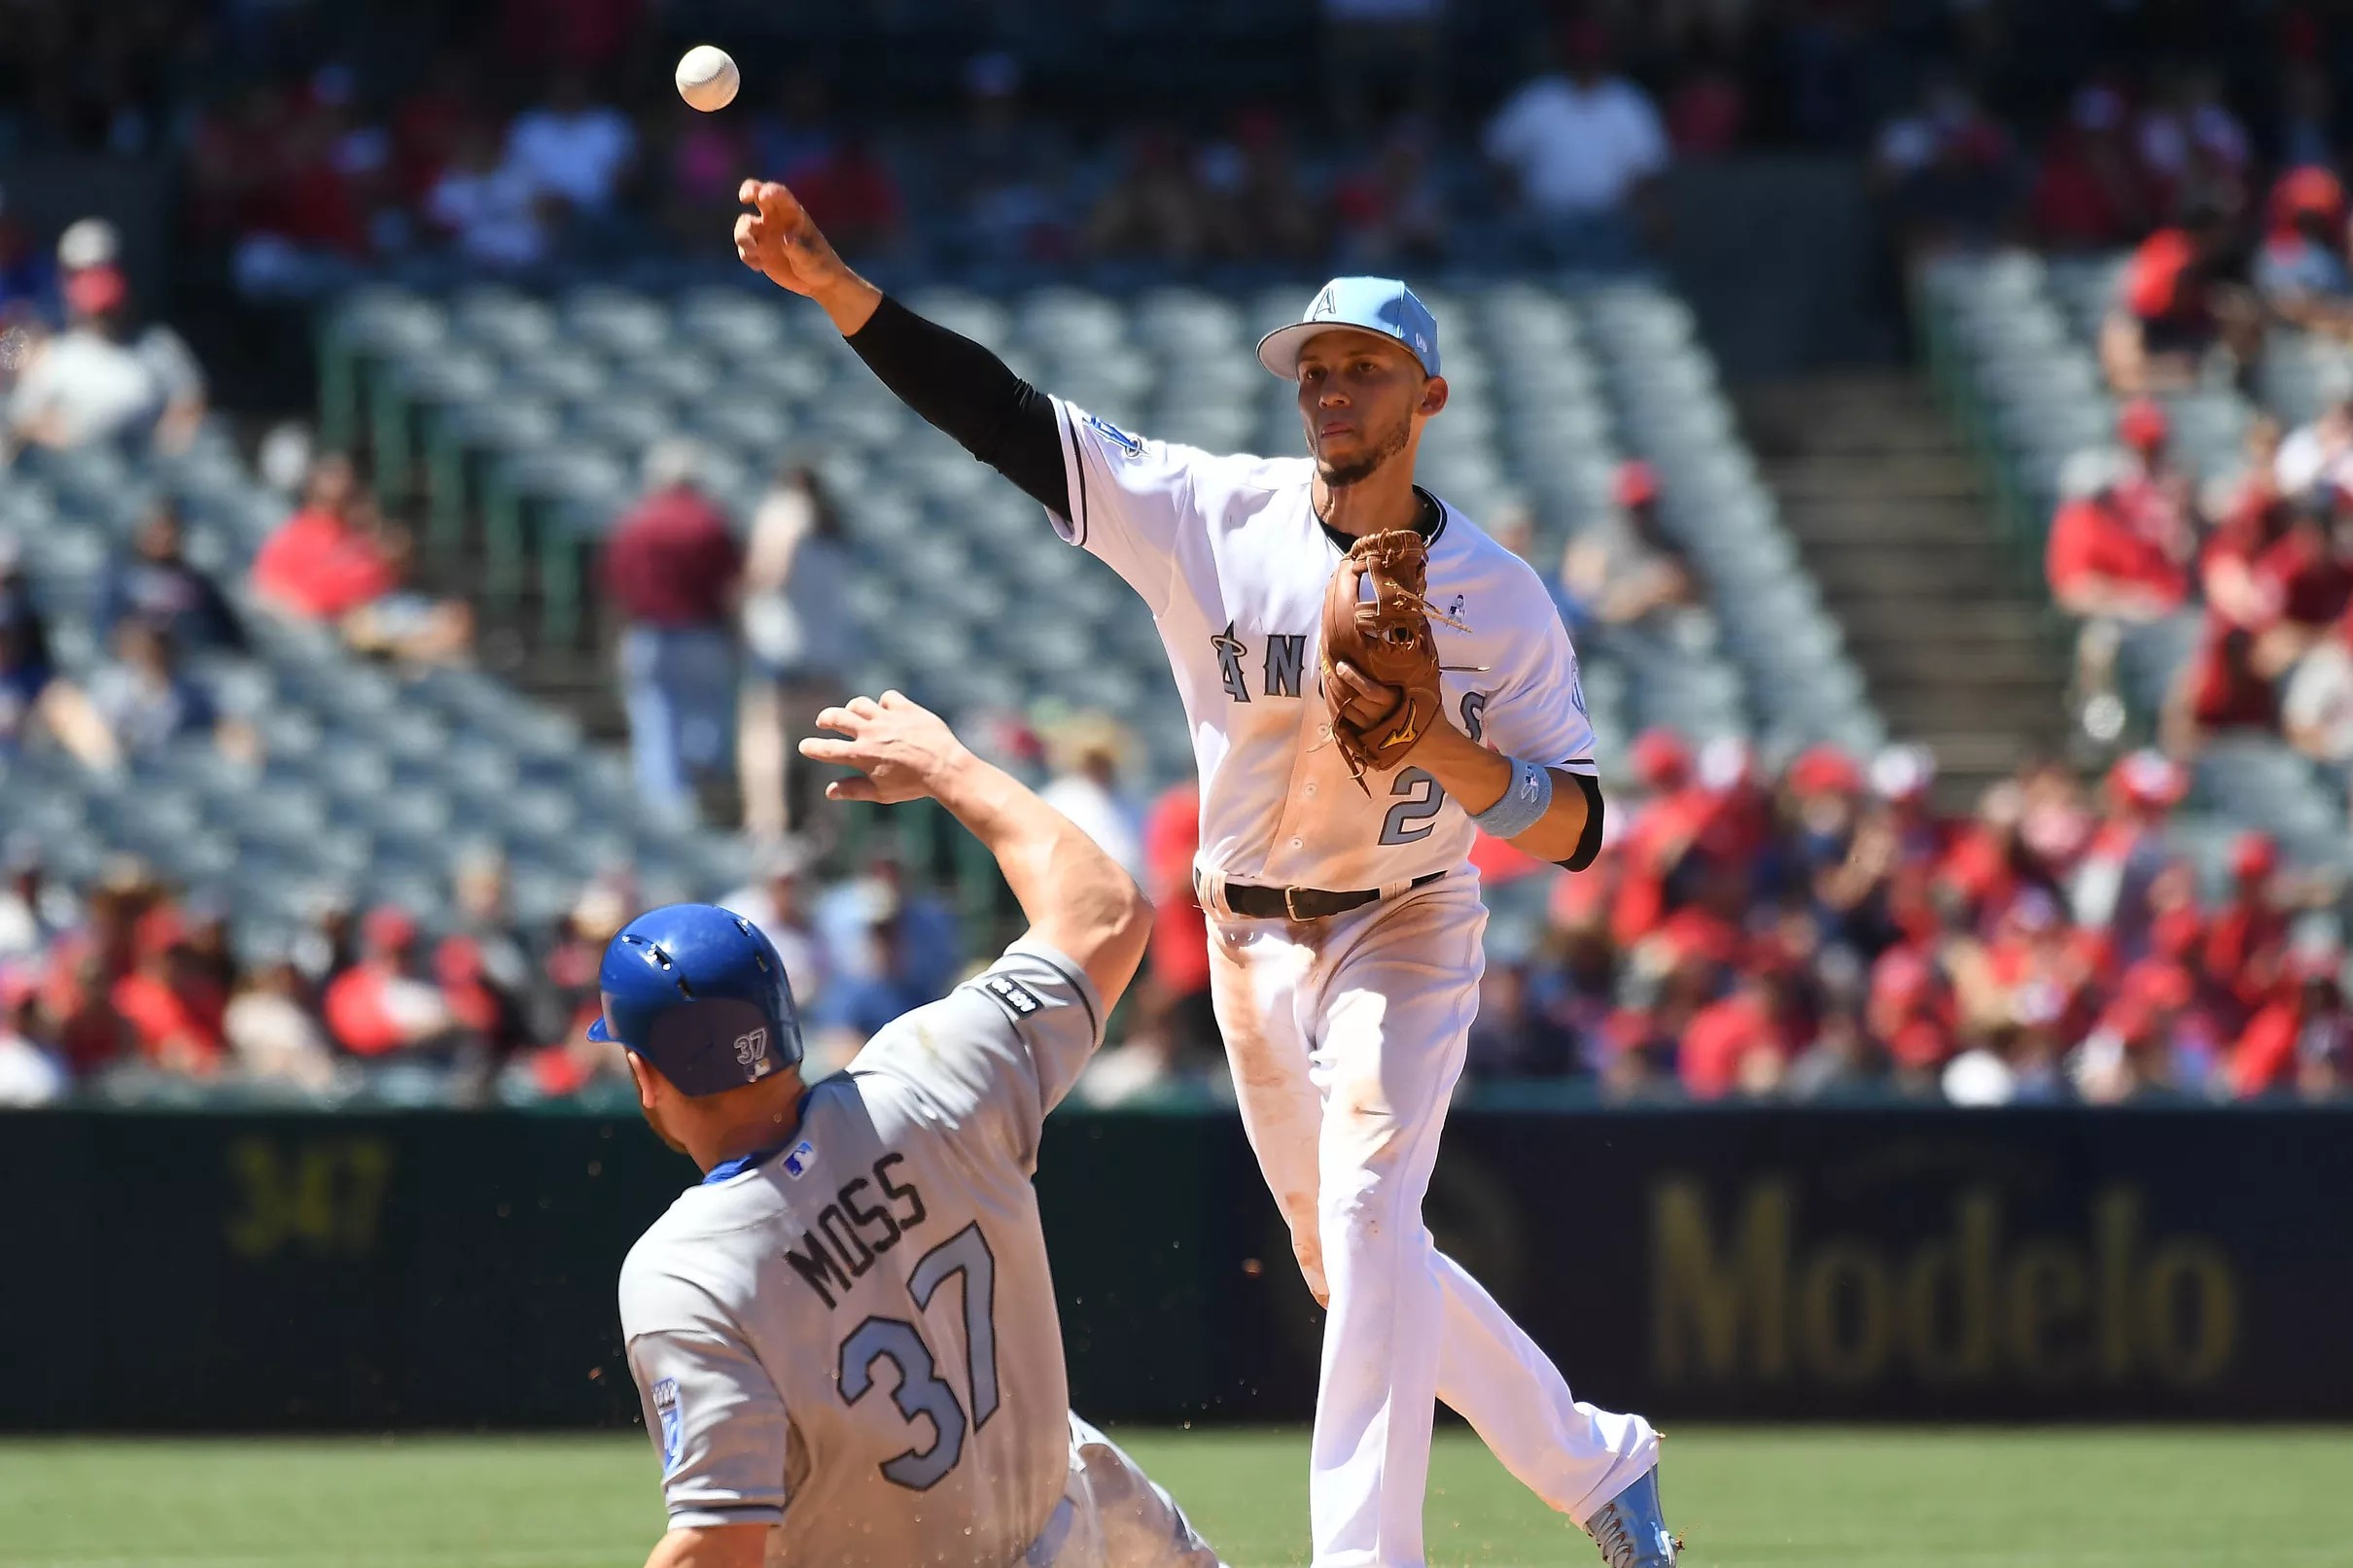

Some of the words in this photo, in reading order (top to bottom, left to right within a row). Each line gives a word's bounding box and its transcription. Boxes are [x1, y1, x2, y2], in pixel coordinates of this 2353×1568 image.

[1313, 288, 1337, 322] A
[1211, 619, 1486, 744] ANS
[1377, 765, 1446, 847] 2
[734, 1027, 767, 1065] 37
[227, 1136, 393, 1260] 347
[783, 1152, 926, 1310] MOSS
[1653, 1178, 2241, 1383] Modelo
[837, 1219, 1000, 1492] 37
